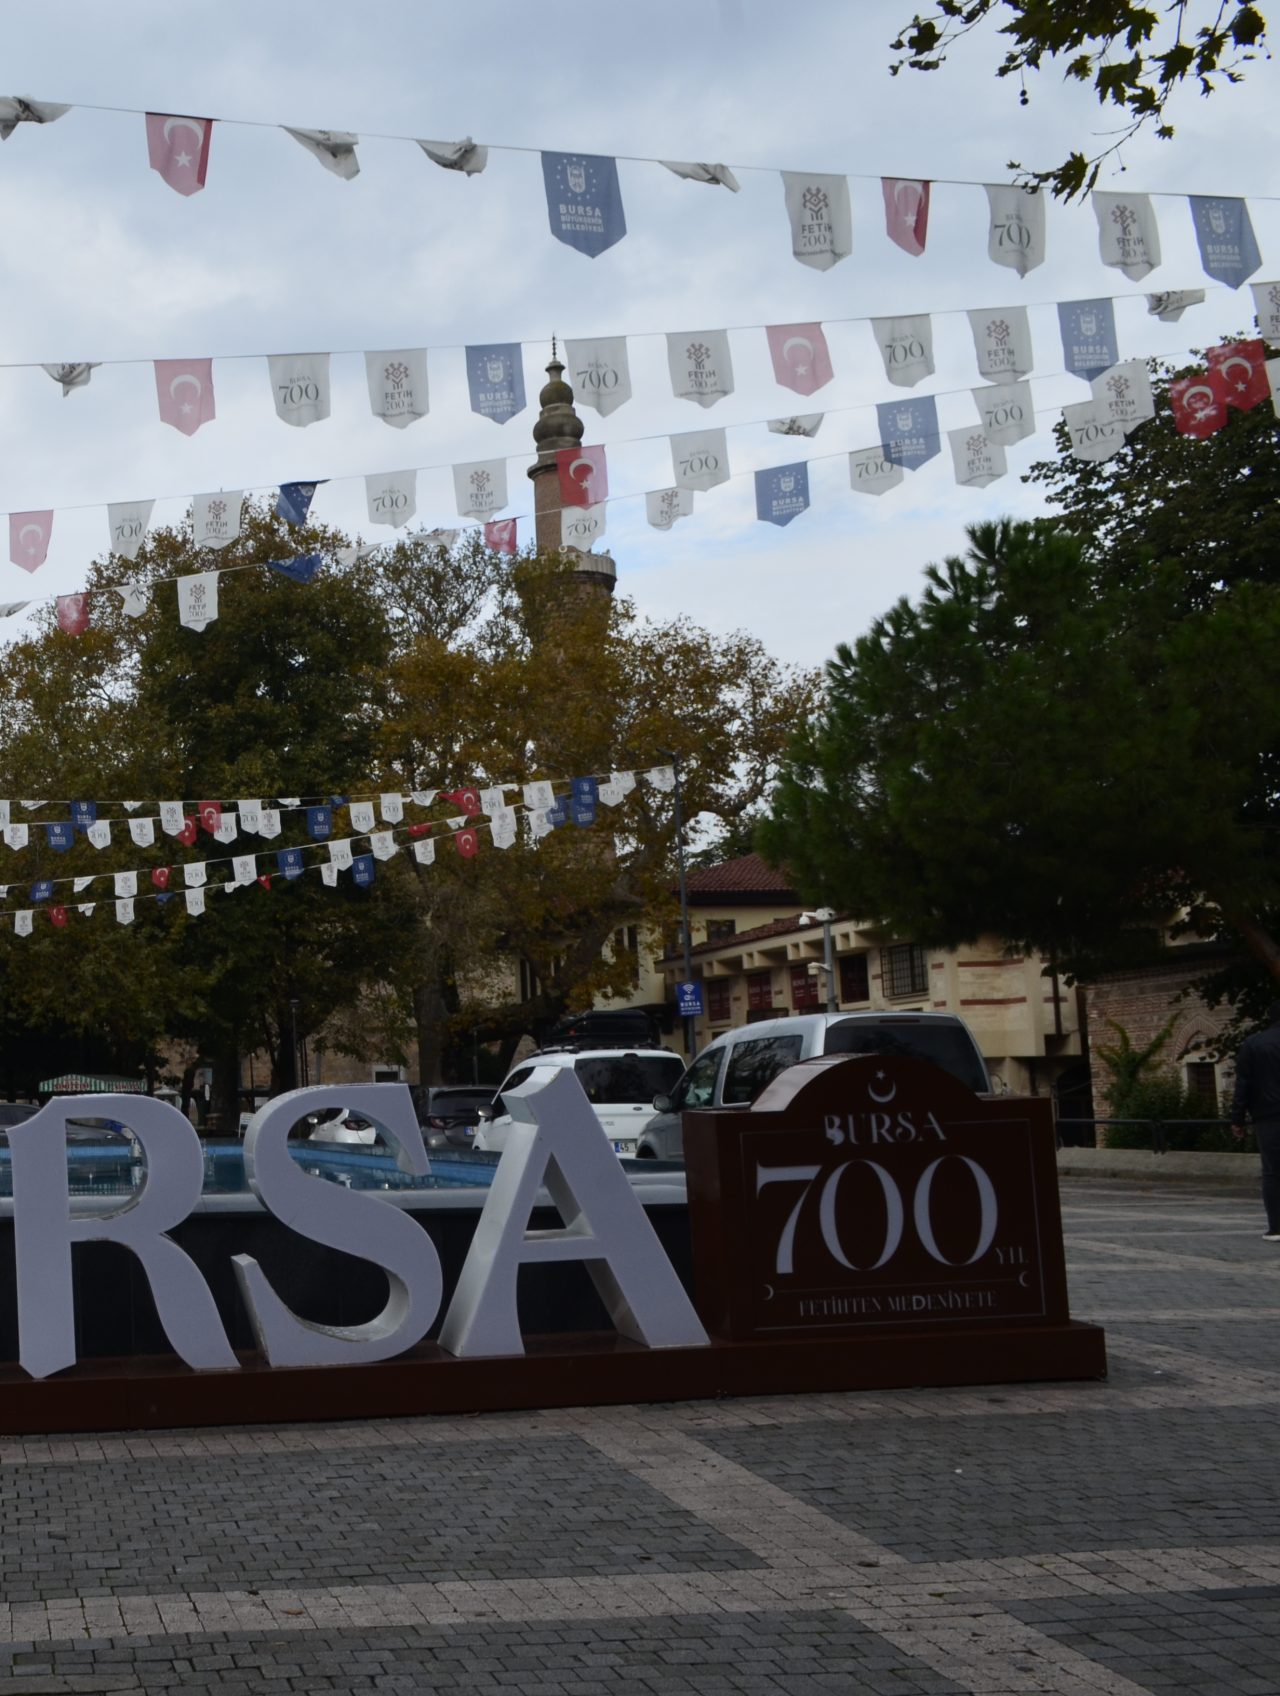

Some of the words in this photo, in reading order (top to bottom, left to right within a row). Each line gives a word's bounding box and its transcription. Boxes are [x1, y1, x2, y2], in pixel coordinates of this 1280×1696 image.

[559, 203, 602, 217] BURSA
[884, 339, 925, 365] 700
[1073, 344, 1109, 354] BURSA
[576, 368, 619, 390] 700
[278, 383, 320, 405] 700
[984, 404, 1024, 429] 700
[679, 454, 719, 477] 700
[855, 460, 895, 478] 700
[372, 493, 408, 512] 700
[115, 521, 143, 541] 700
[566, 518, 599, 537] 700
[823, 1110, 948, 1147] BURSA
[755, 1153, 1000, 1275] 700
